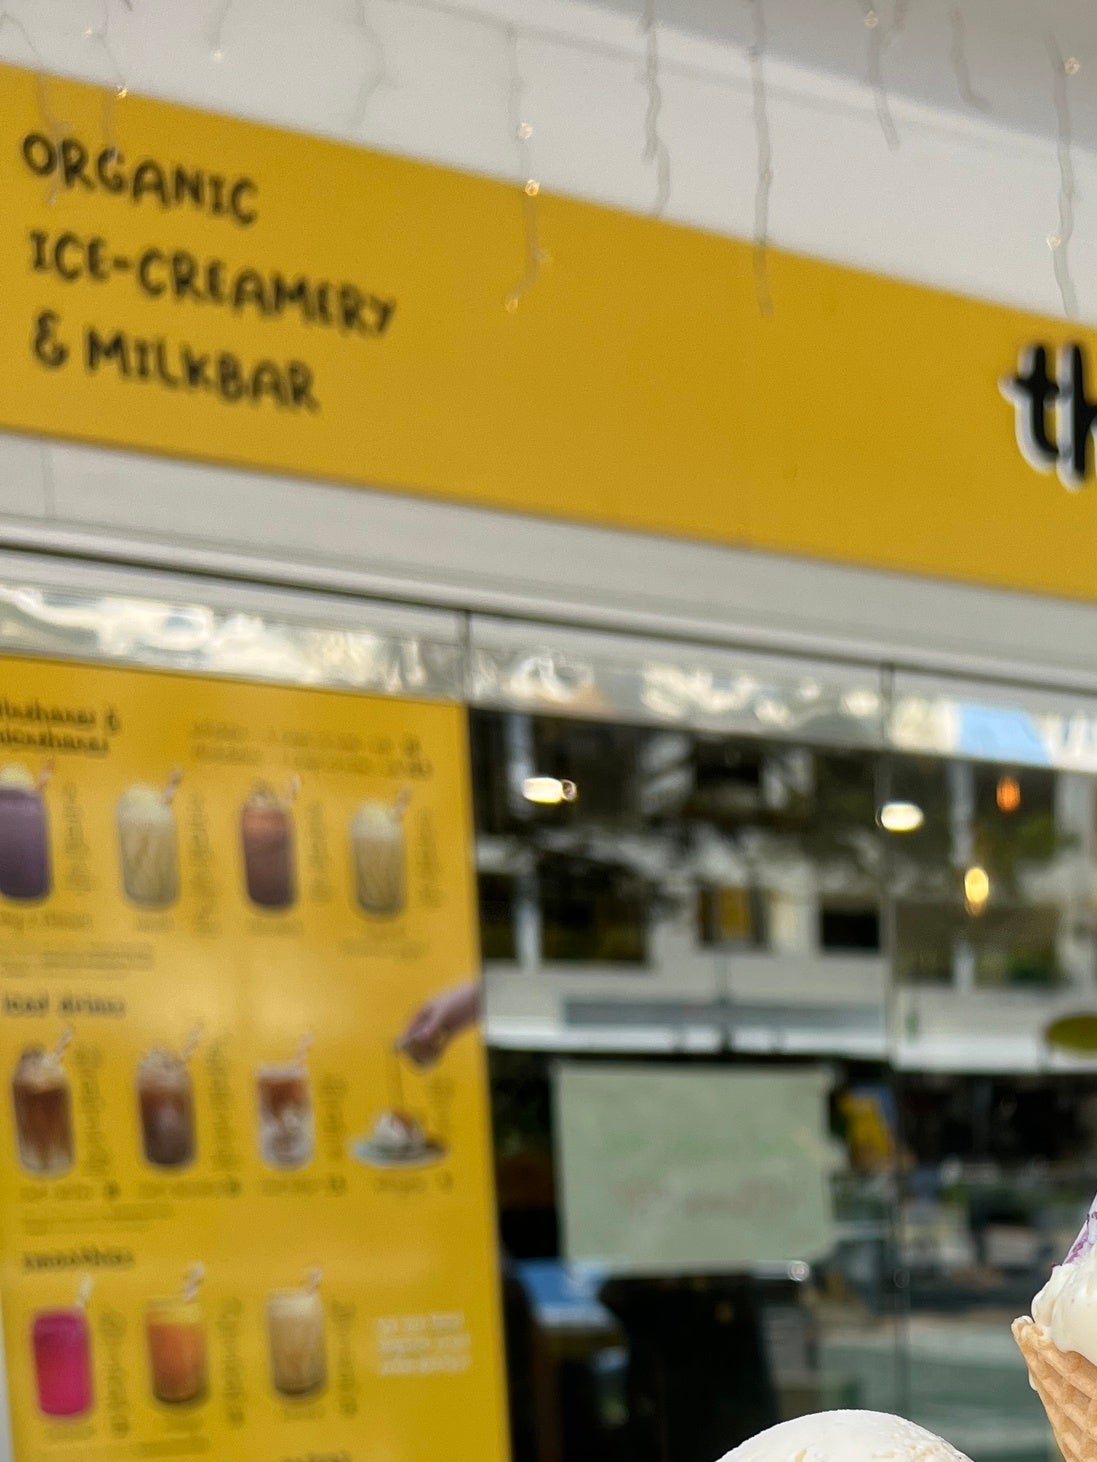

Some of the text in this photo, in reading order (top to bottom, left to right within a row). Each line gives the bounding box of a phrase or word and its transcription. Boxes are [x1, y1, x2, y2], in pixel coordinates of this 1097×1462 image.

[22, 132, 256, 226] ORGANIC
[27, 229, 396, 338] ICE-CREAMERY
[32, 310, 319, 412] & MILKBAR
